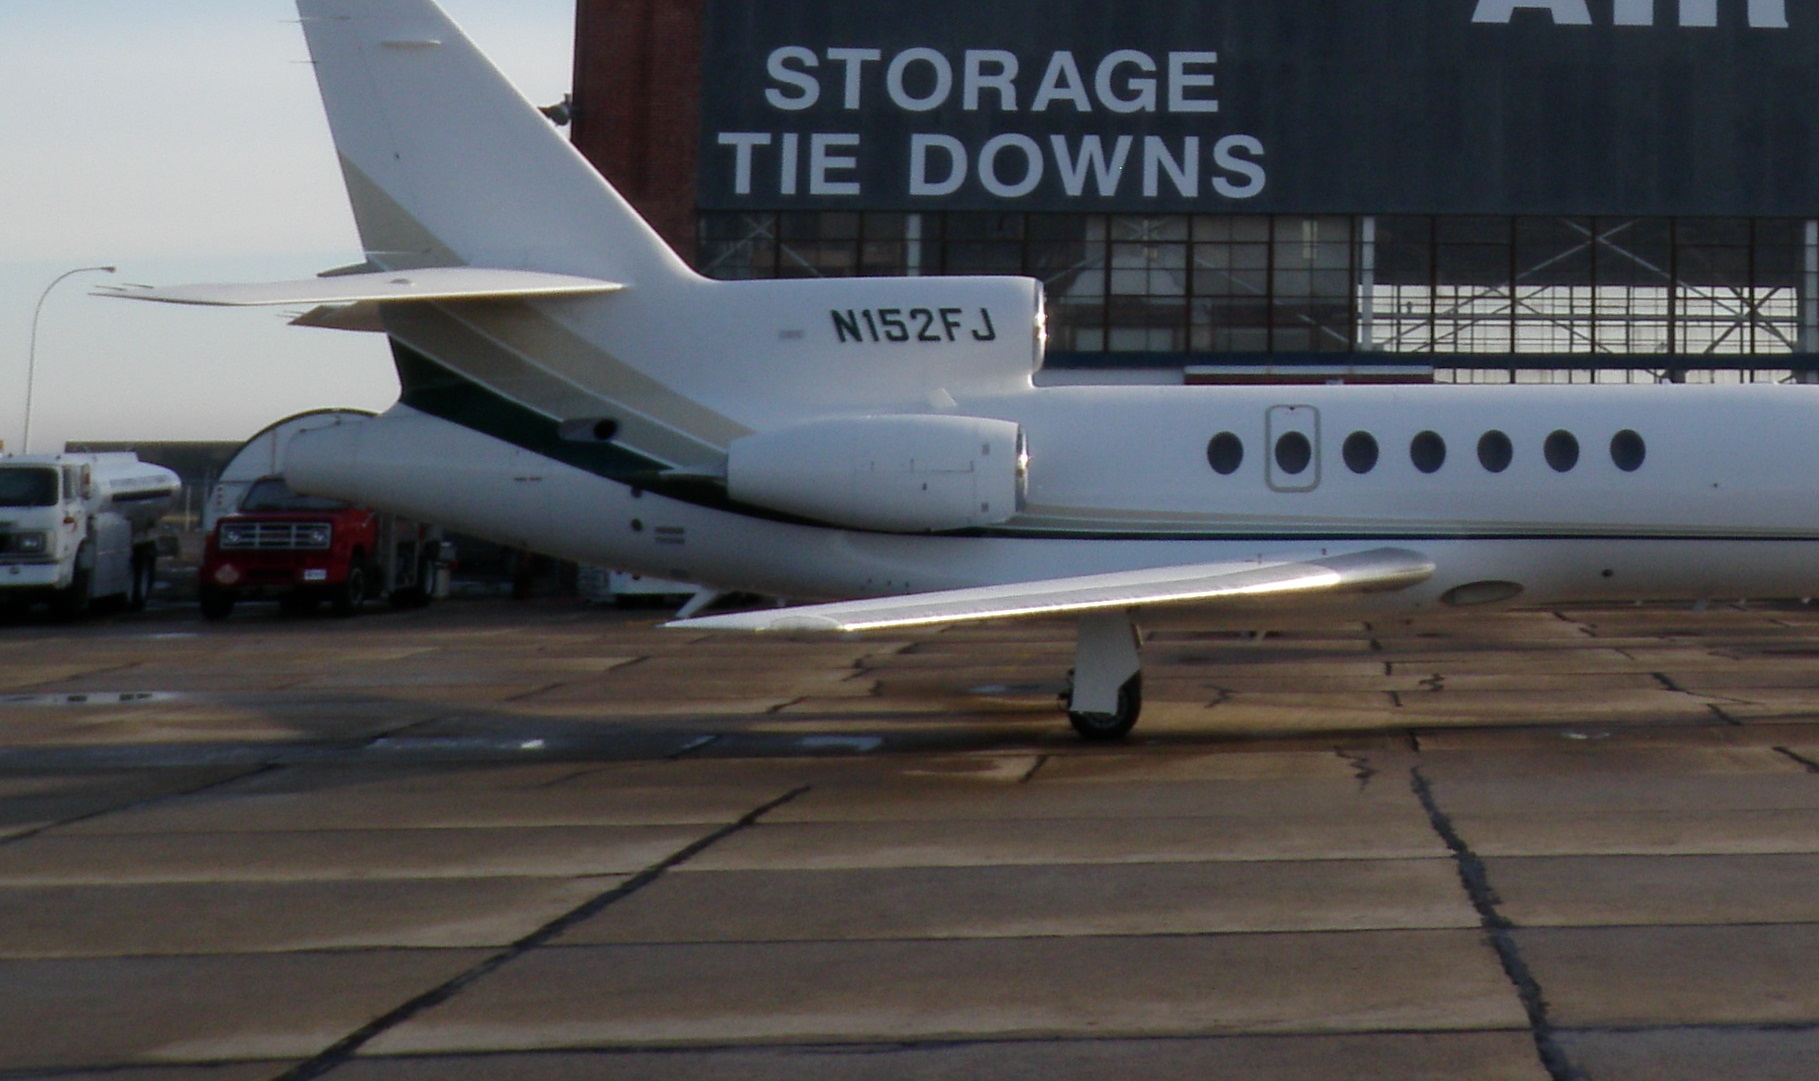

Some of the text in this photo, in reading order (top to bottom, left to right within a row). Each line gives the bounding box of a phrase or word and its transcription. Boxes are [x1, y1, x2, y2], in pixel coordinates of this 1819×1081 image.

[764, 45, 1219, 113] STORAGE
[717, 132, 1267, 199] TIE DOWNS
[830, 307, 997, 343] N152FJ
